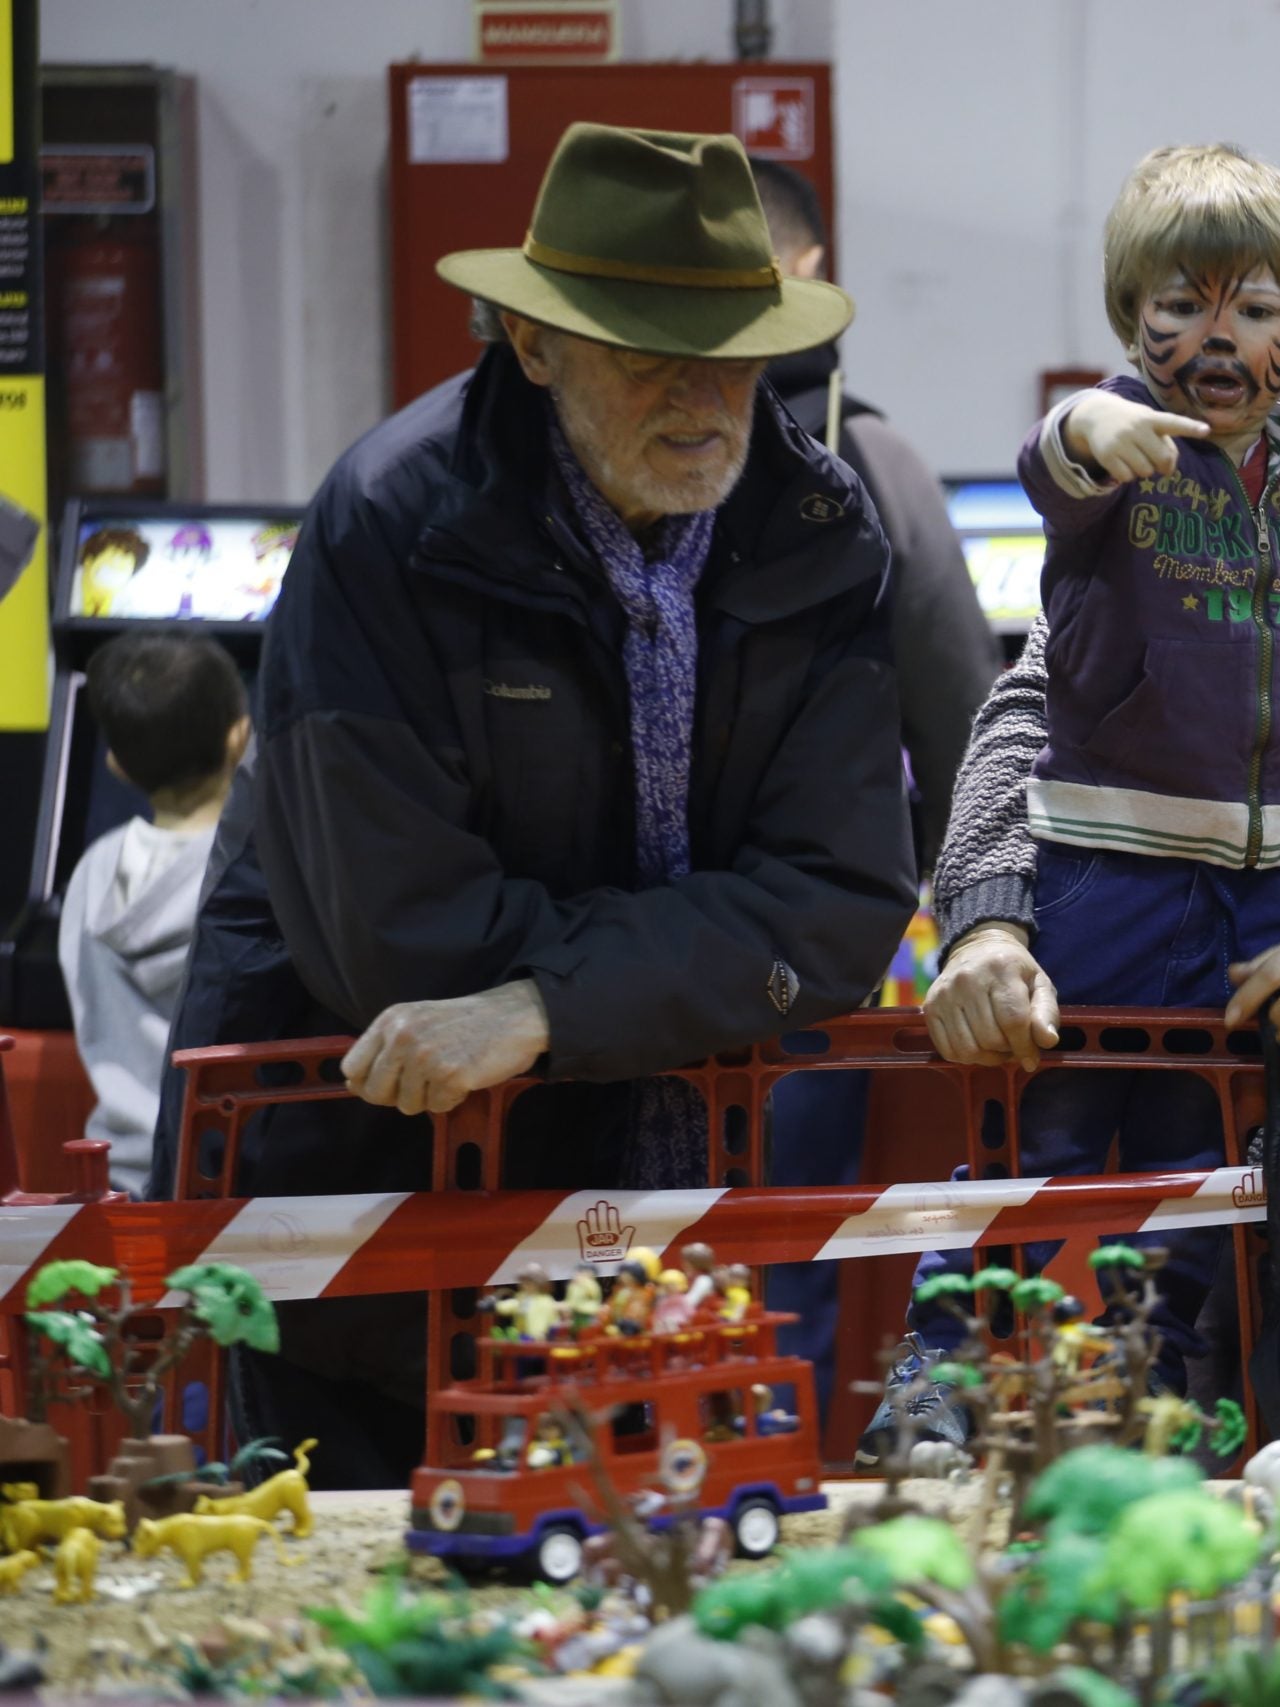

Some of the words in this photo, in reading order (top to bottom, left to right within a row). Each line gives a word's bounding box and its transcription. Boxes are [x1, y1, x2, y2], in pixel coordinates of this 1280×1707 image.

[1153, 554, 1256, 588] Member
[1238, 1193, 1267, 1204] DANGE
[586, 1249, 622, 1258] DANGER
